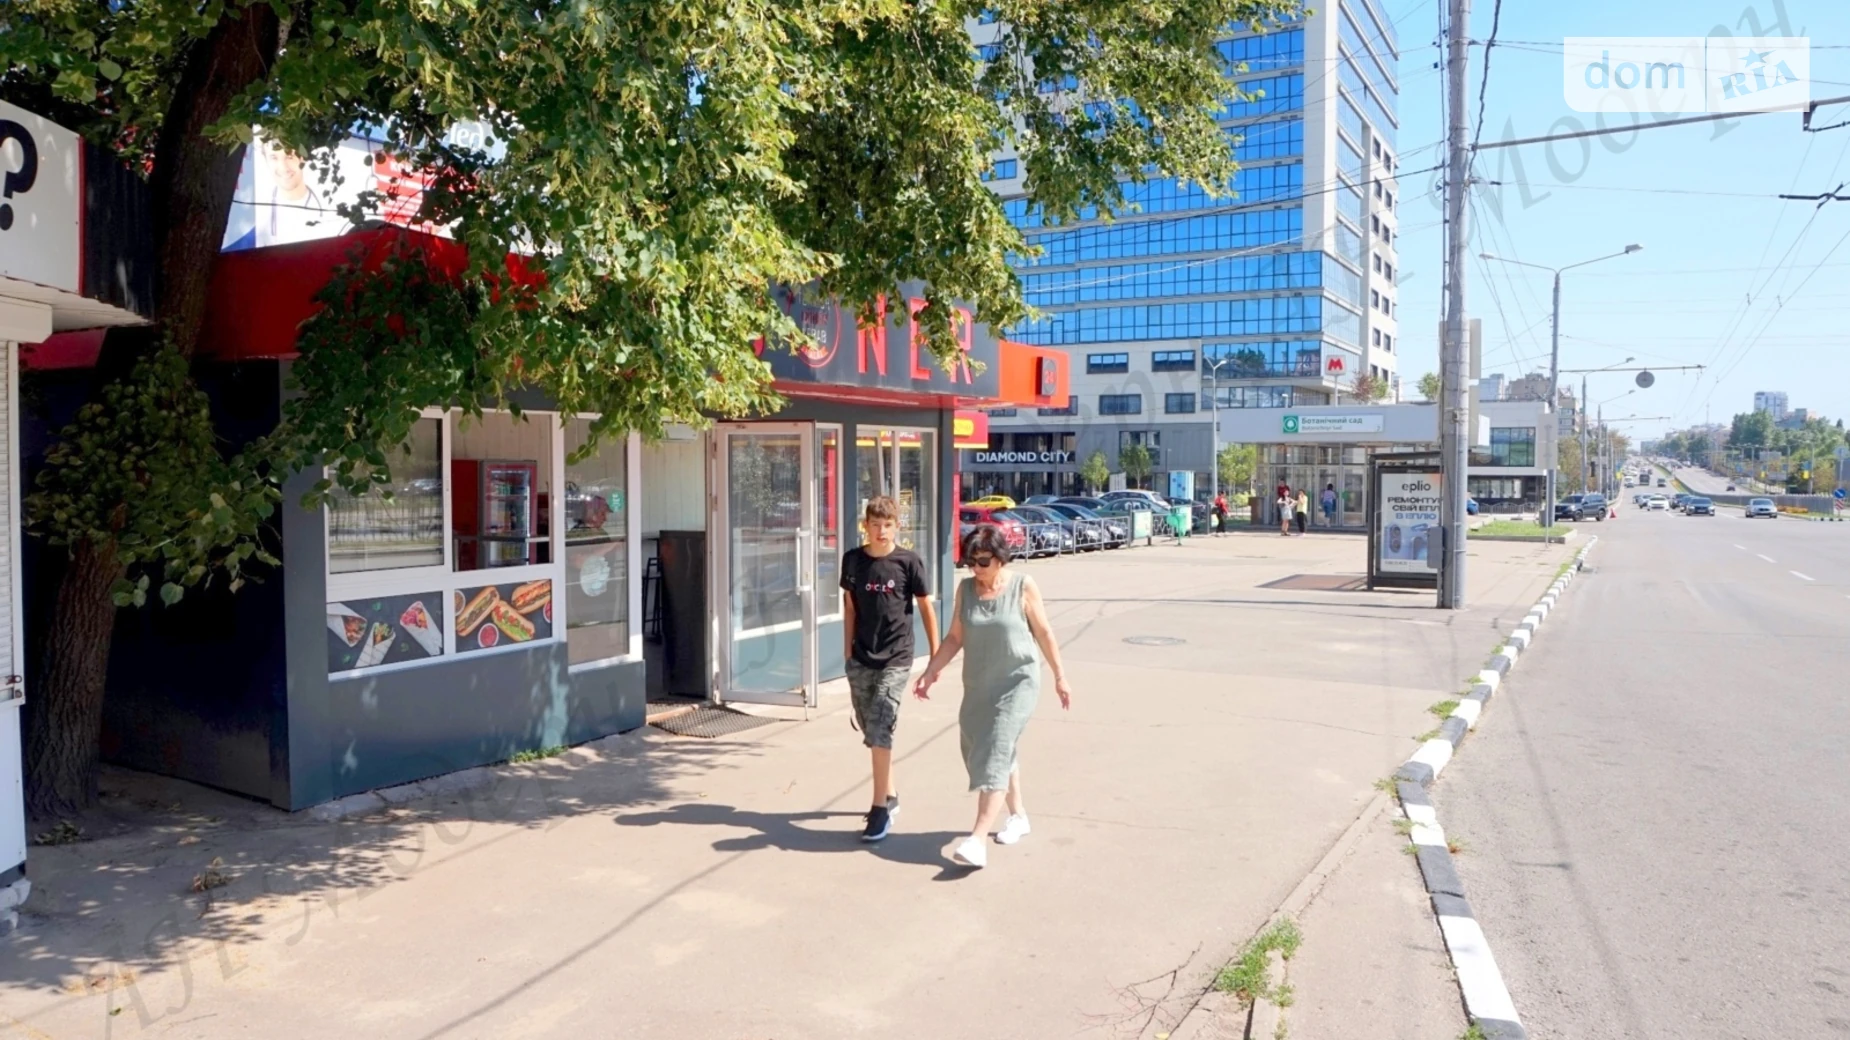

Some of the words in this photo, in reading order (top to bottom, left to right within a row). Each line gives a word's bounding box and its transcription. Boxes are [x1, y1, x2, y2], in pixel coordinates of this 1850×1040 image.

[1301, 417, 1347, 425] Ботанічний
[1349, 417, 1363, 425] сад
[976, 451, 1037, 463] DIAMOND
[1040, 451, 1070, 463] CITY
[1401, 480, 1432, 494] eplio
